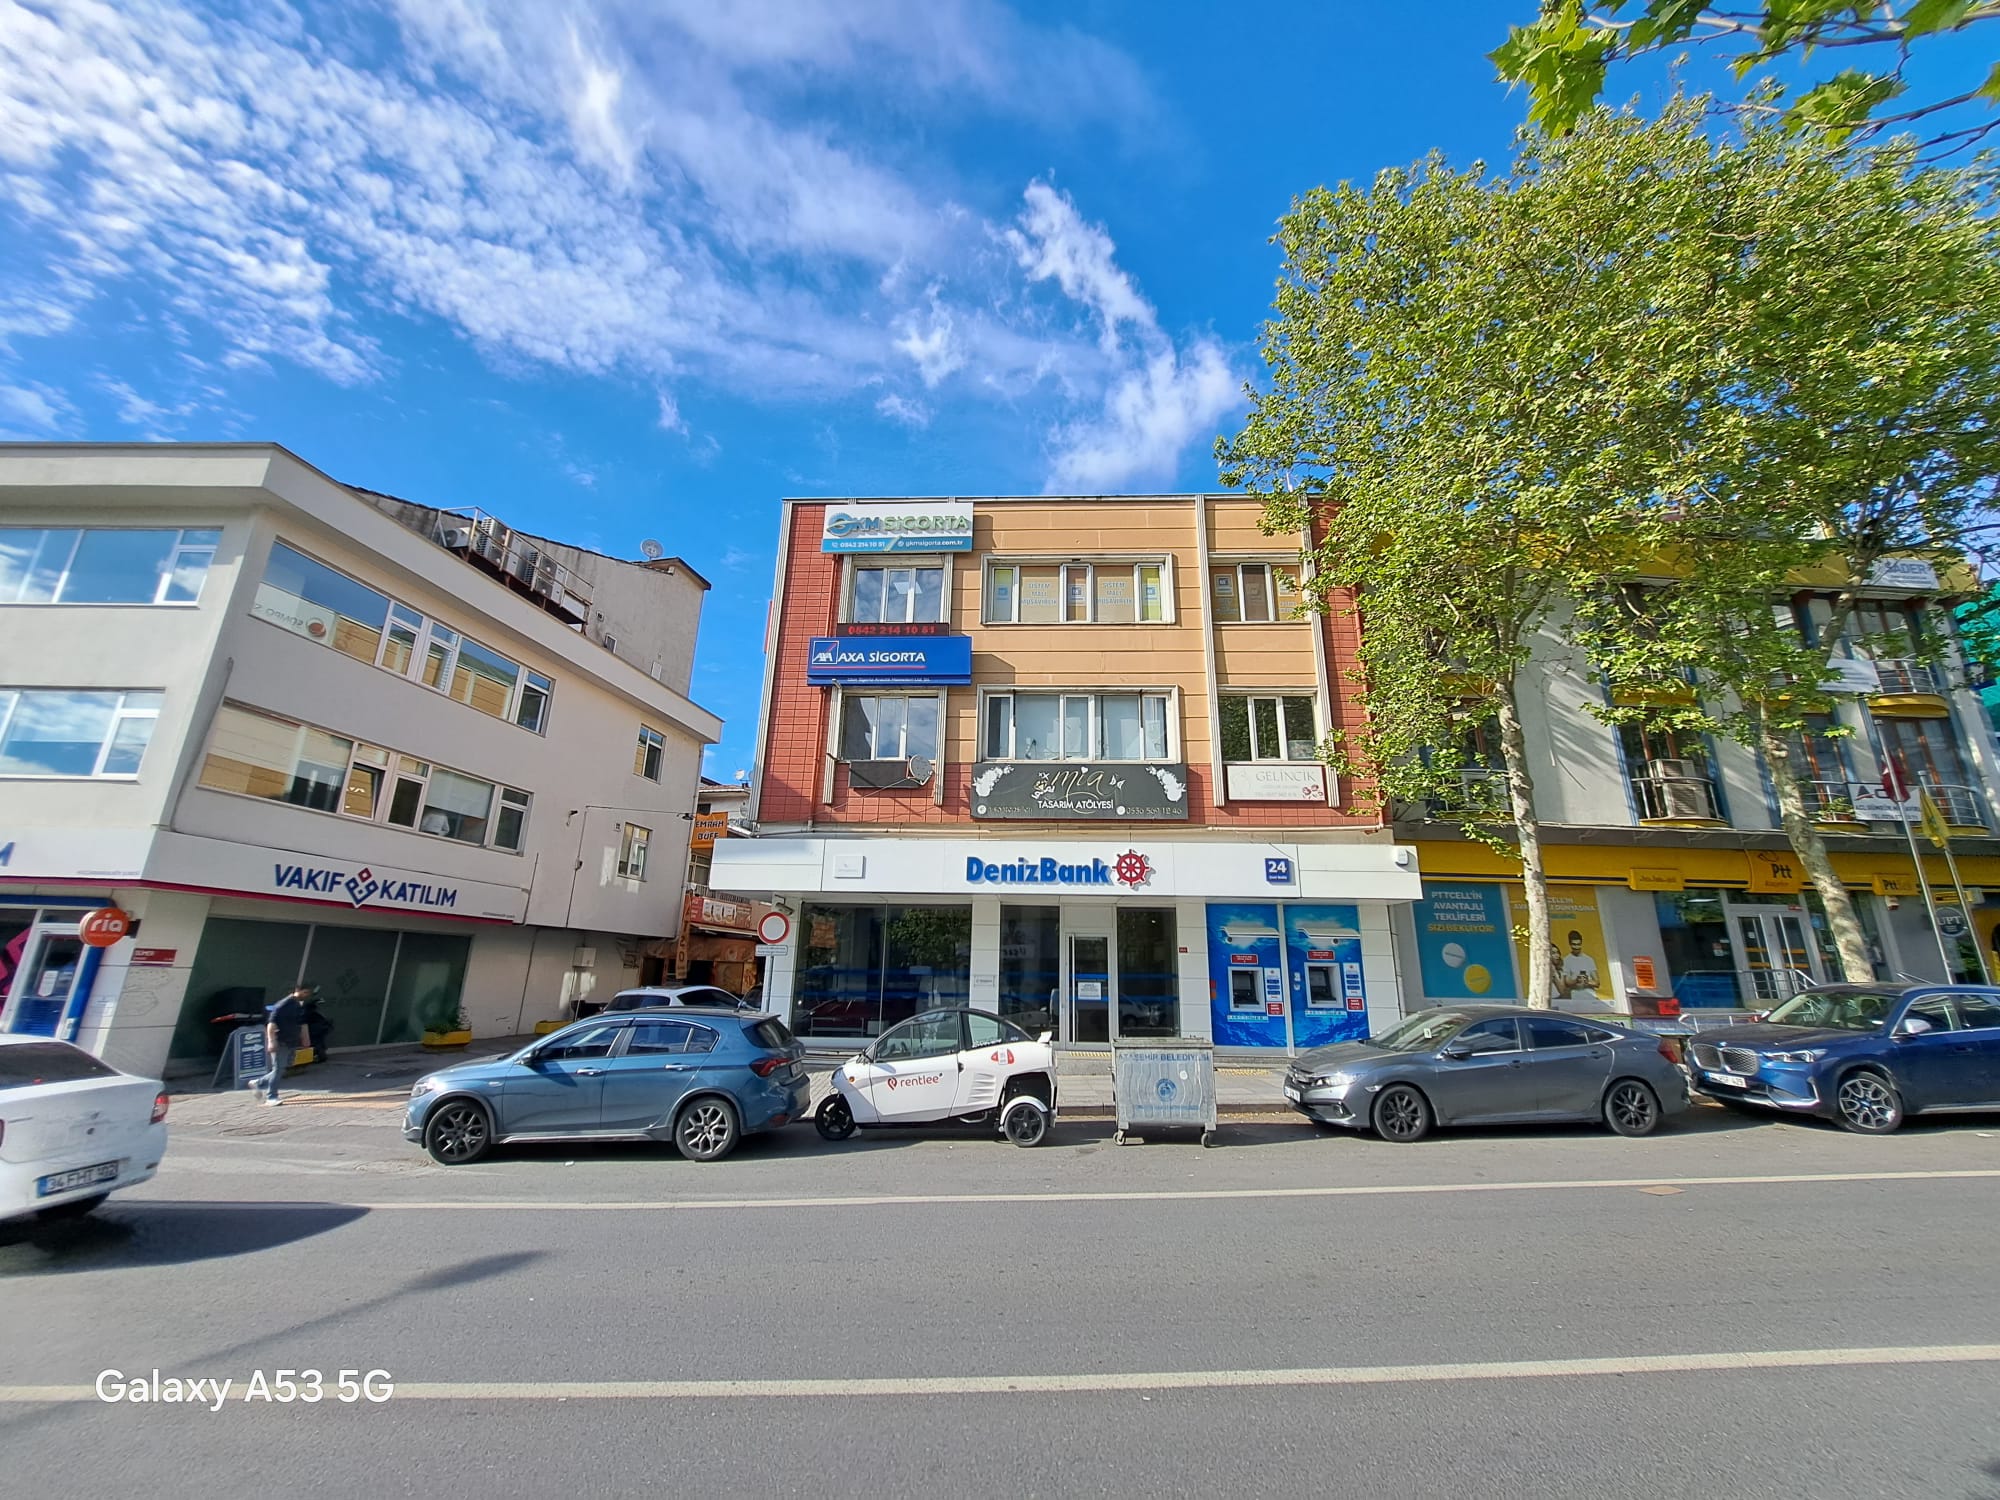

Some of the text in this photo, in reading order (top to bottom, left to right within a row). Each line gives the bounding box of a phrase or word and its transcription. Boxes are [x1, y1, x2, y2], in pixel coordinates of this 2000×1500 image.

[905, 539, 963, 547] gkmsigorta.com.tr
[813, 652, 833, 662] AXA
[838, 651, 926, 662] AXA SİGORTA
[1050, 767, 1106, 798] mia
[1038, 799, 1114, 810] TASARIM ATÖLYESİ
[966, 856, 1109, 884] DenizBank
[1268, 860, 1287, 873] 24
[1772, 863, 1792, 879] Ptt
[275, 864, 458, 907] VAKIF KATILIM
[1882, 880, 1899, 891] Ptt
[1433, 902, 1484, 911] AVANTAJLI
[90, 912, 122, 932] ria
[1433, 911, 1486, 922] TEKLİFLERİ
[901, 1072, 939, 1088] rentlee
